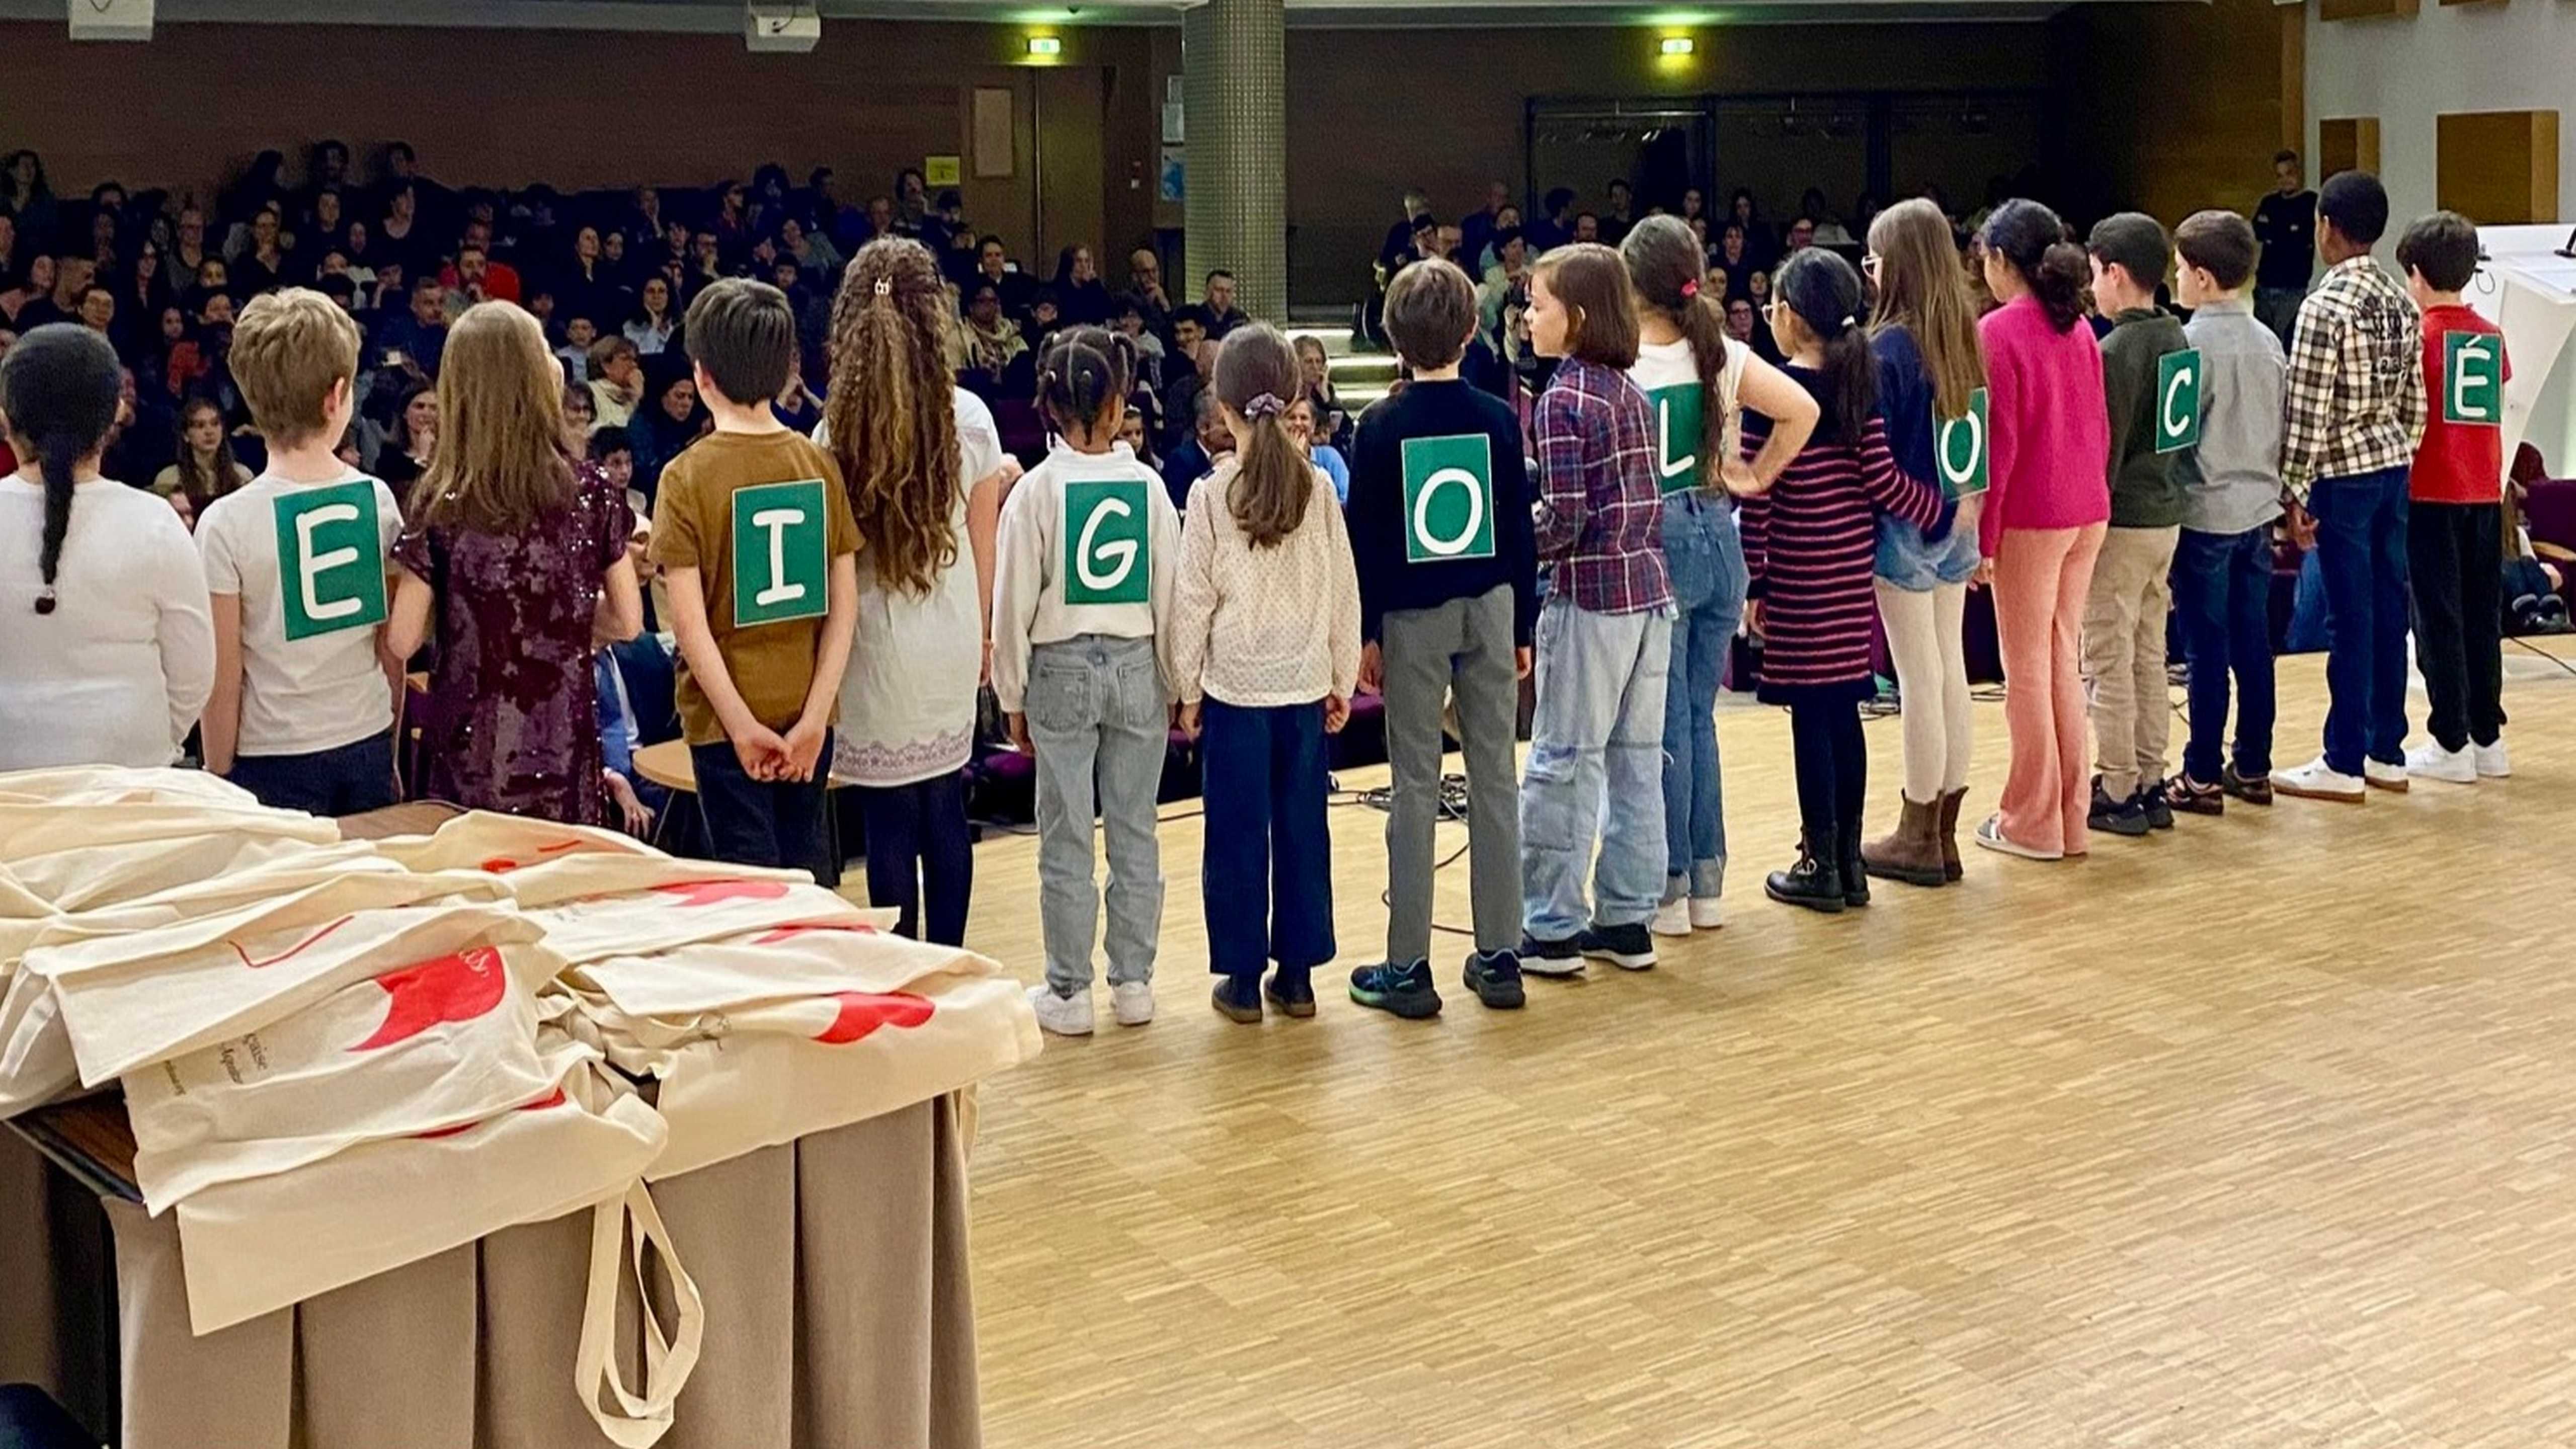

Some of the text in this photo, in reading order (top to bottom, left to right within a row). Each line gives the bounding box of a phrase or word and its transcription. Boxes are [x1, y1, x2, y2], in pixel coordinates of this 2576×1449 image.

[2164, 362, 2192, 437] C
[2454, 335, 2491, 418] É
[1660, 398, 1695, 477] L
[1940, 409, 1981, 484] O
[1077, 497, 1138, 590] G
[1414, 467, 1483, 554] O
[295, 504, 361, 619] E
[753, 509, 805, 606] I
